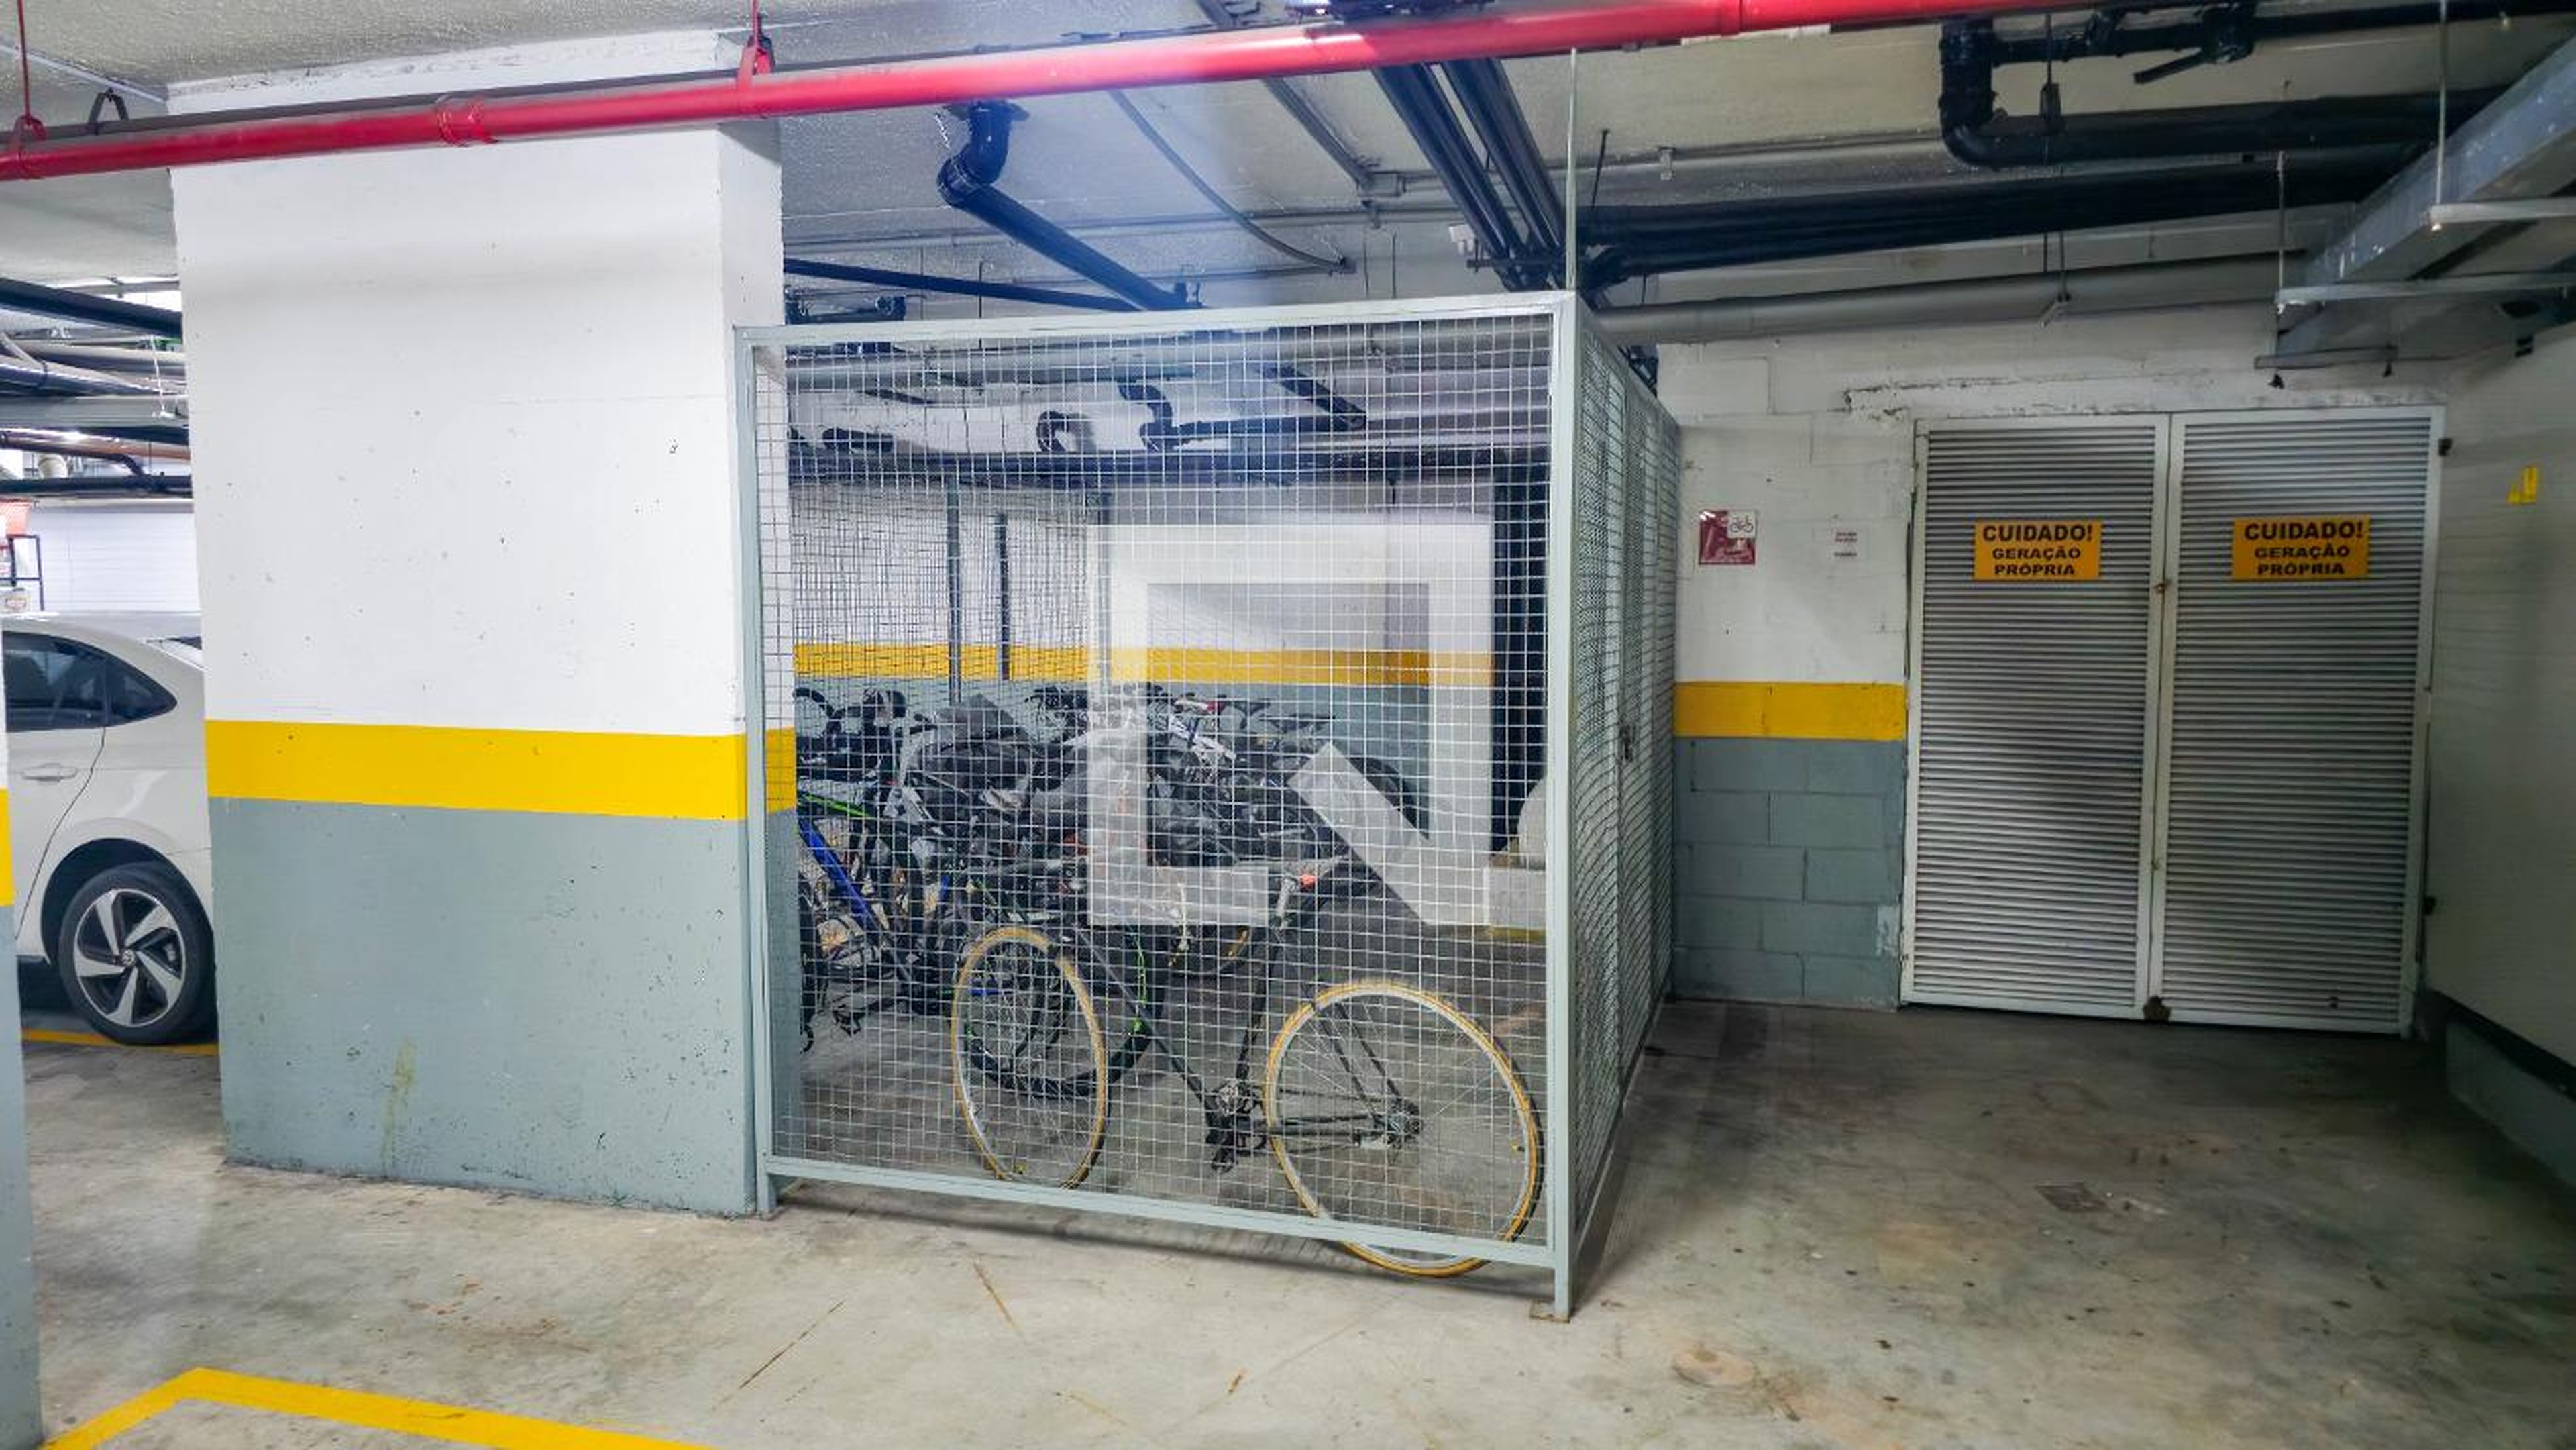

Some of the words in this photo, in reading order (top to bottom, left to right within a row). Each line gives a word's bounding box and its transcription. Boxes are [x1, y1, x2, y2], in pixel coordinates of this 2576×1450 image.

[1983, 524, 2092, 541] CUIDADO!
[2244, 521, 2363, 540] CUIDADO!
[1992, 546, 2081, 560] GERAÇÃO
[2255, 543, 2351, 560] GERAÇÃO
